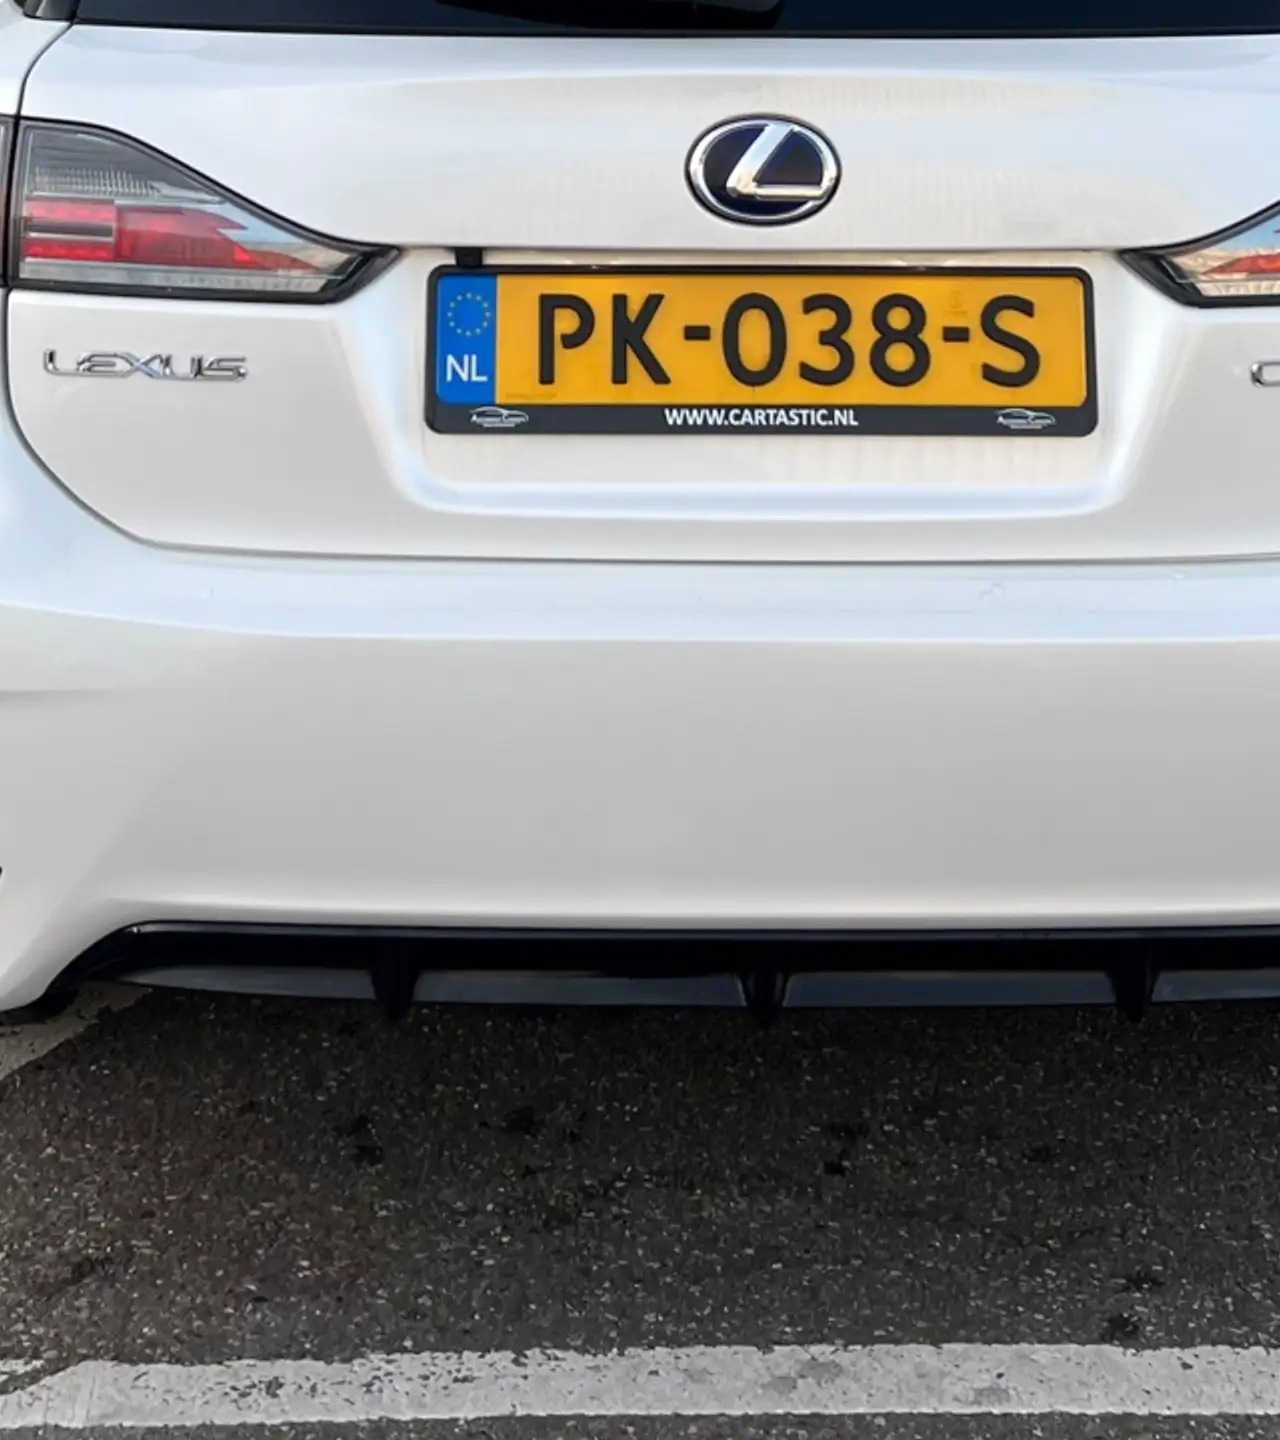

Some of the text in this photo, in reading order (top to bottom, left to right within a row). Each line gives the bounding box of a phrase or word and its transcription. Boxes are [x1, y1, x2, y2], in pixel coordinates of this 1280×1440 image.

[537, 292, 1041, 388] PK-038-S
[42, 348, 248, 383] LEXUS
[445, 354, 488, 382] NL
[663, 407, 859, 428] WWW.CARTASTIC.NL
